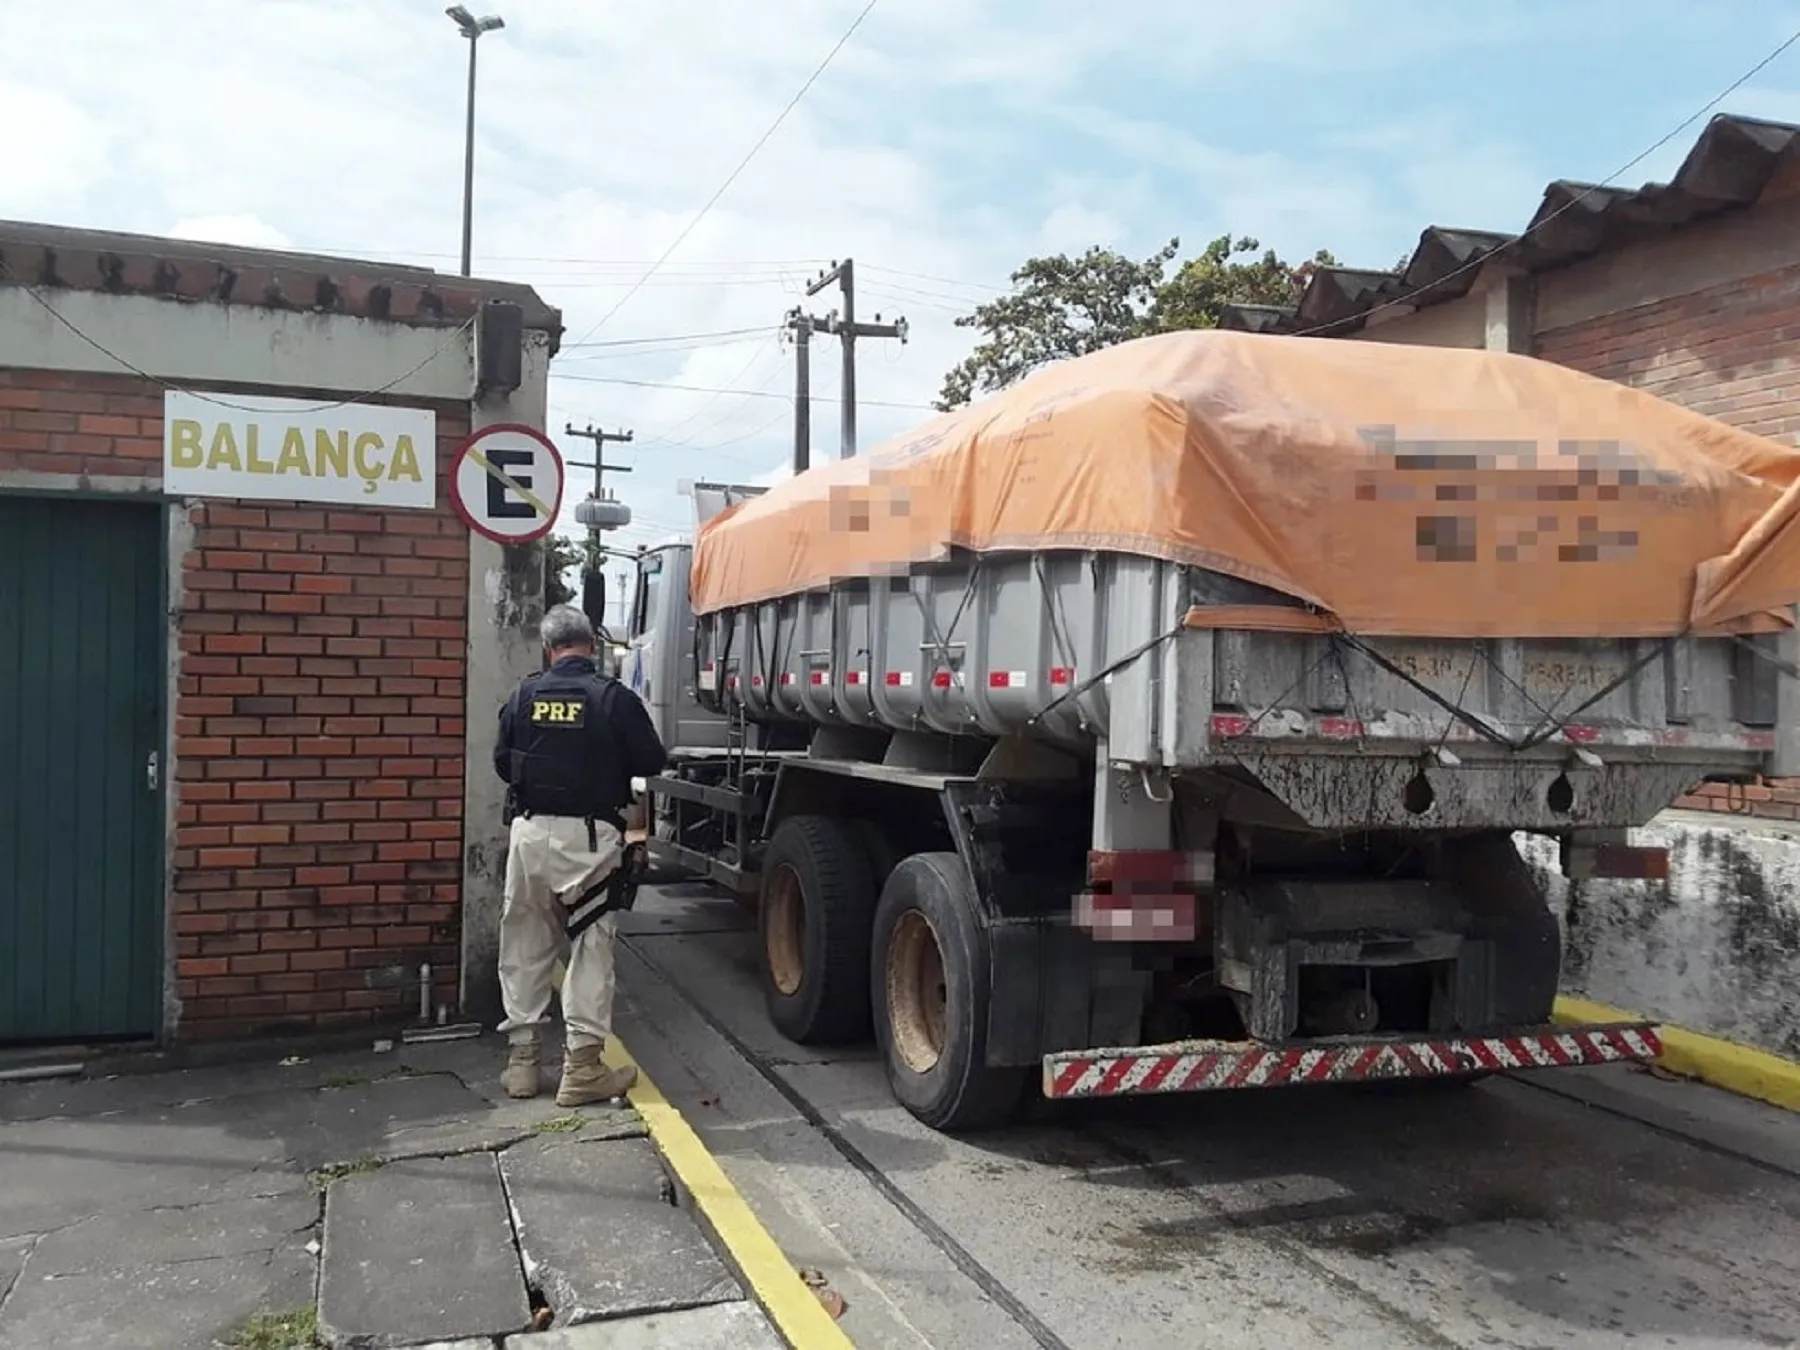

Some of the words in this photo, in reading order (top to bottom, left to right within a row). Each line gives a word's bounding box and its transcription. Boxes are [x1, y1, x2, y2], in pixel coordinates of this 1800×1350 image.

[171, 419, 422, 494] BALANÇA
[486, 449, 537, 518] E
[532, 701, 582, 721] PRF
